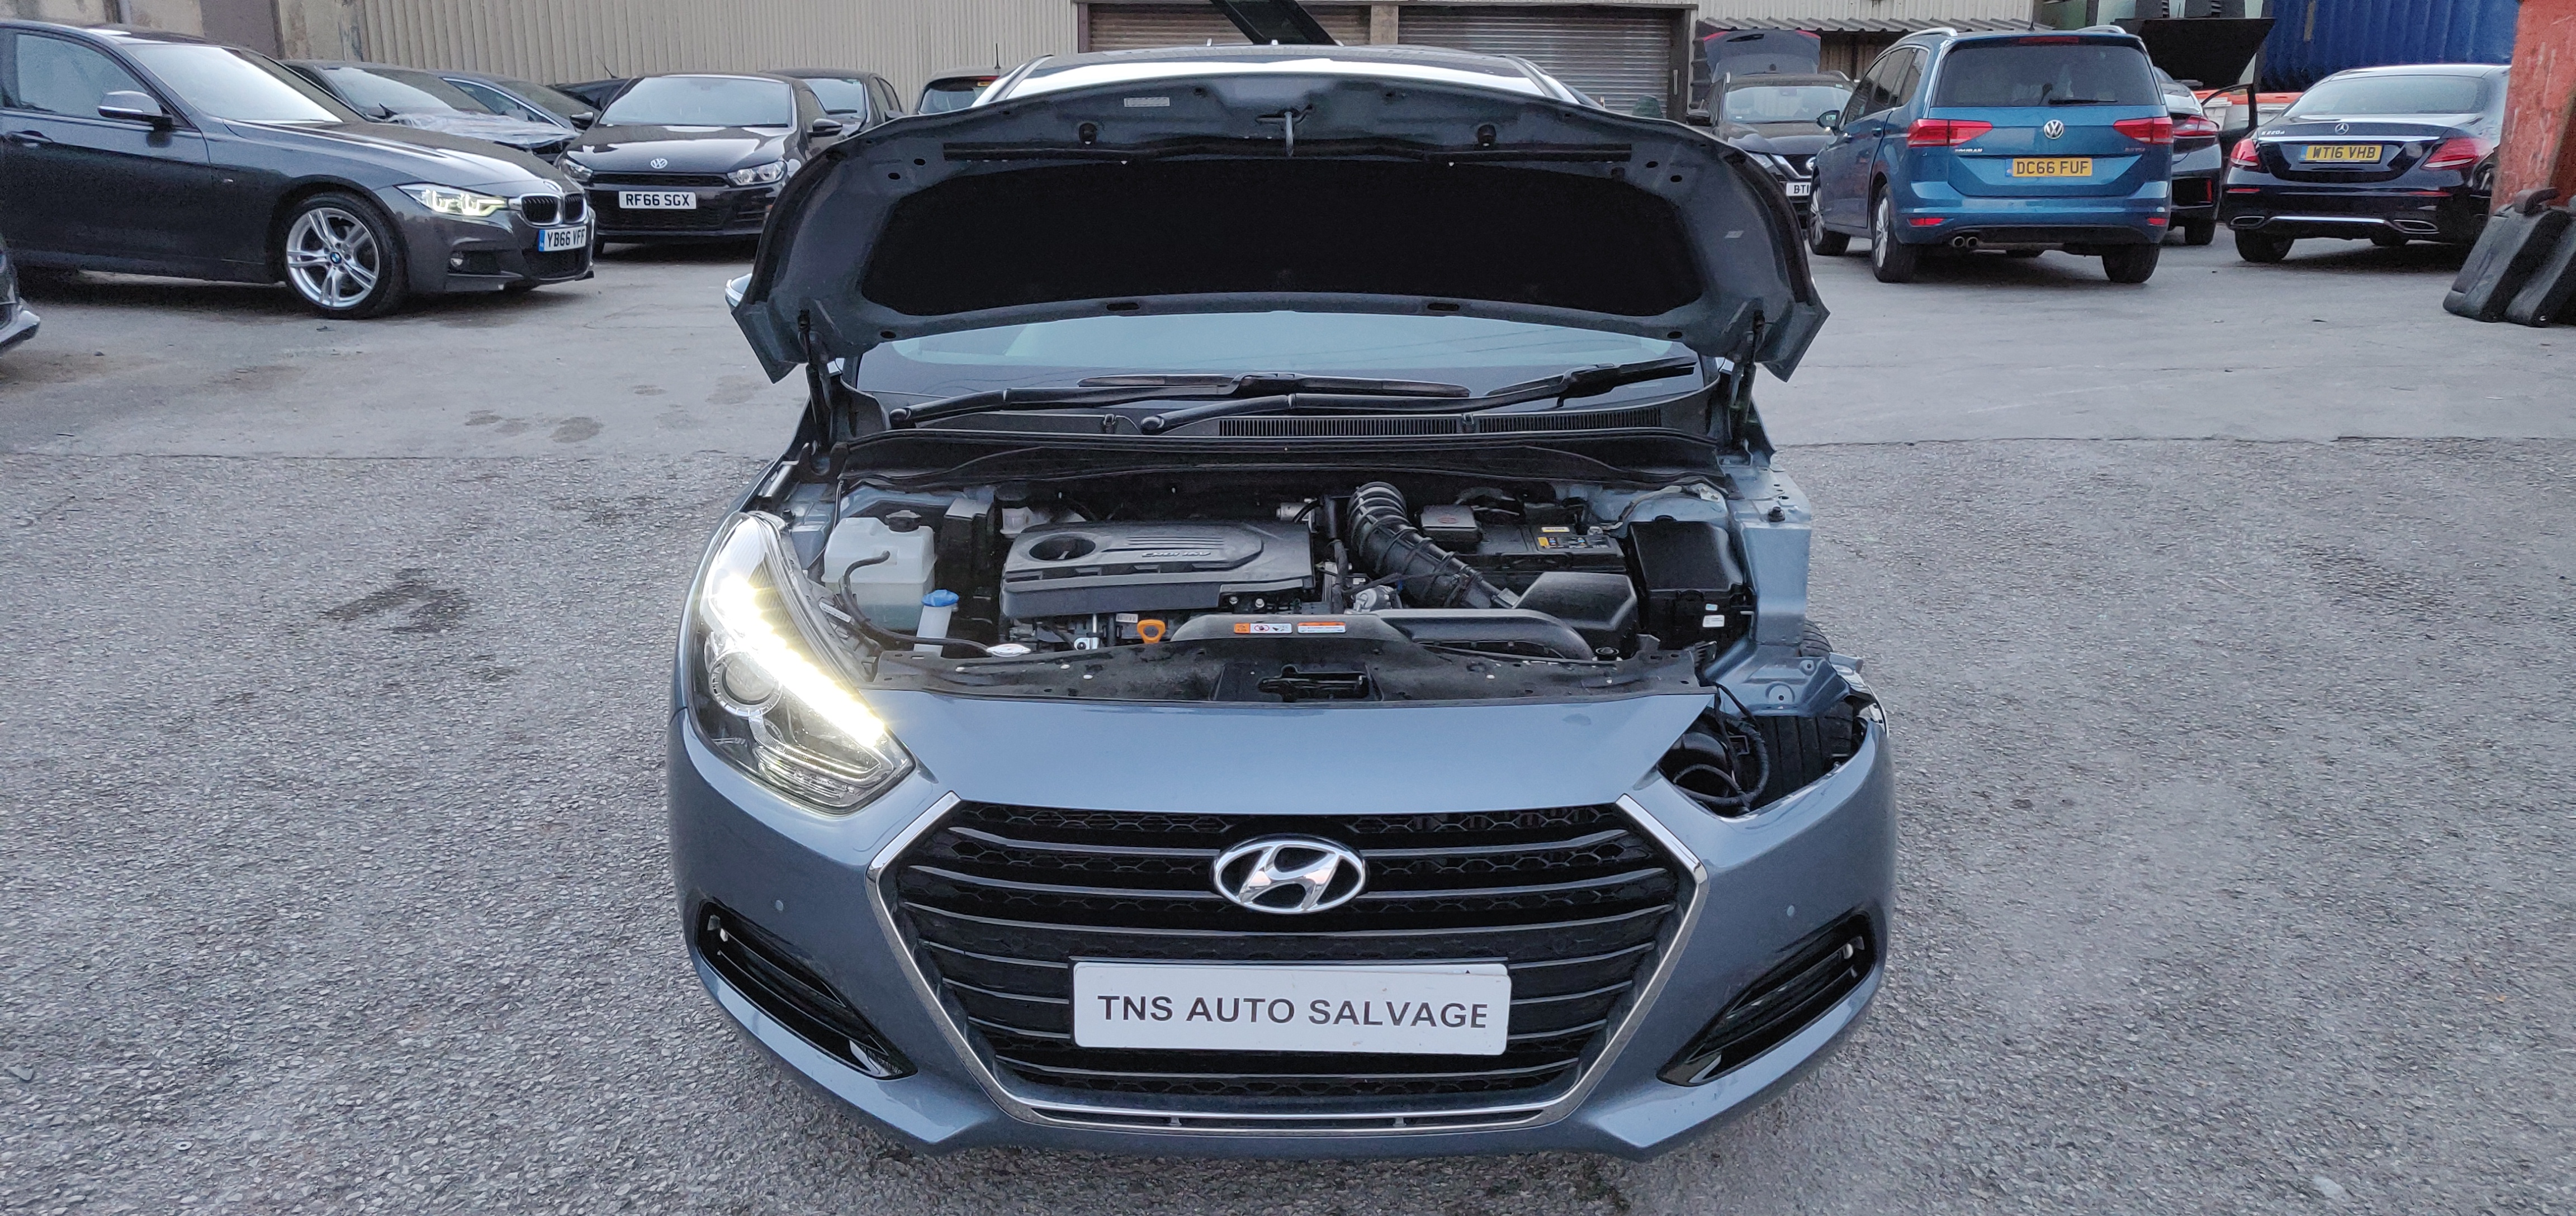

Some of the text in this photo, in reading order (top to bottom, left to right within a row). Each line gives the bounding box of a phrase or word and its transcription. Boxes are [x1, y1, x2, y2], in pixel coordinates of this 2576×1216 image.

[2312, 146, 2376, 159] WT16 VHB
[2016, 160, 2089, 174] DC66 FUF
[626, 193, 690, 206] RF66 SGX
[547, 228, 585, 248] YB66 VFF
[1097, 995, 1488, 1029] TNS AUTO SALVAGE
